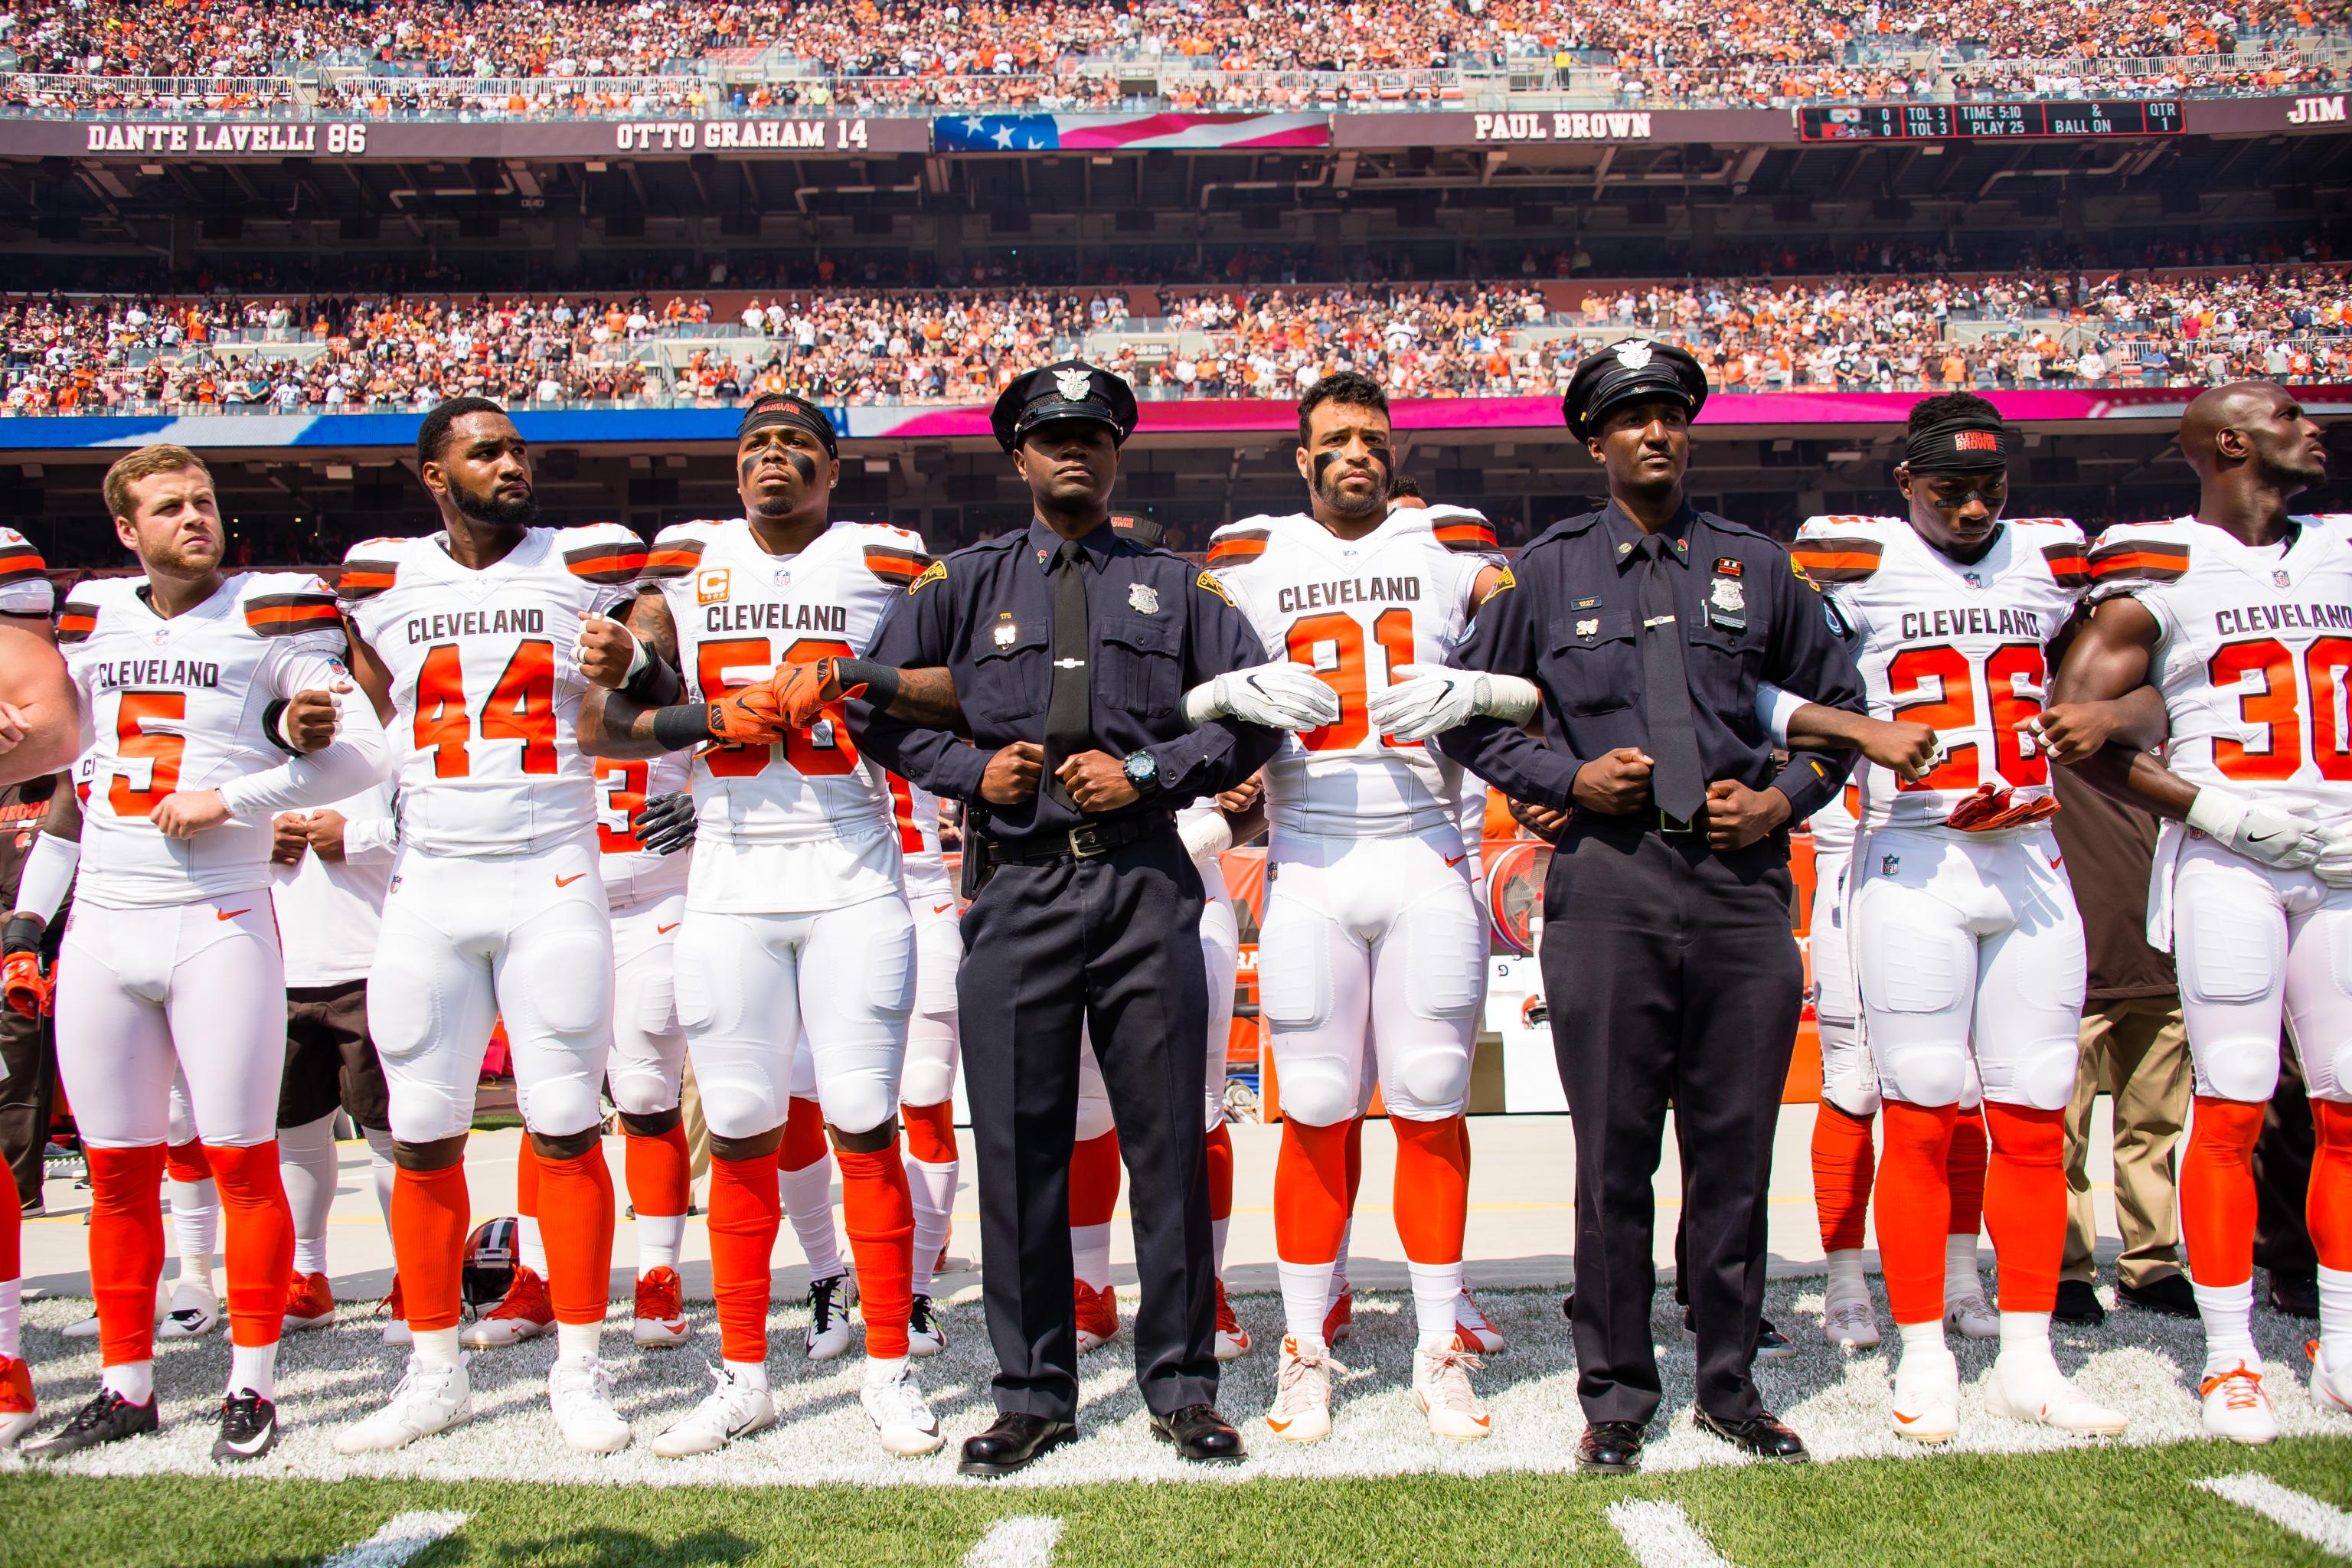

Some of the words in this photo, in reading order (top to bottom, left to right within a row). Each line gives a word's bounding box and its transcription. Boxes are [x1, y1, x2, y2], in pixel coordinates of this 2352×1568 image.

[1881, 108, 1890, 121] 0
[1907, 108, 1932, 121] TOL
[1938, 107, 1946, 120] 3
[1961, 106, 1994, 119] TIME
[1999, 106, 2021, 119] 5:10
[2091, 104, 2102, 117] &
[2149, 103, 2176, 116] QTR
[2287, 96, 2347, 124] JIM
[87, 125, 188, 152] DANTE
[195, 125, 315, 152] LAVELLI
[328, 124, 367, 153] 86
[616, 122, 696, 149] OTTO
[704, 121, 825, 149] GRAHAM
[838, 119, 867, 149] 14
[1475, 113, 1547, 140] PAUL
[1553, 113, 1651, 139] BROWN
[1883, 122, 1892, 136] 0
[1909, 122, 1934, 136] TOL
[1940, 122, 1948, 135] 3
[1973, 122, 2004, 136] PLAY
[2010, 121, 2025, 134] 25
[2054, 119, 2089, 133] BALL
[2092, 119, 2112, 132] ON
[2161, 118, 2169, 131] 1
[699, 572, 728, 595] C
[1279, 577, 1420, 612] CLEVELAND
[408, 609, 544, 645] CLEVELAND
[707, 603, 847, 633] CLEVELAND
[1902, 608, 2040, 640] CLEVELAND
[2215, 603, 2352, 636] CLEVELAND
[99, 659, 219, 688] CLEVELAND
[1285, 608, 1426, 751] 91
[413, 639, 560, 779] 44
[1886, 642, 2049, 792] 26
[2207, 634, 2352, 782] 30
[108, 690, 187, 817] 5
